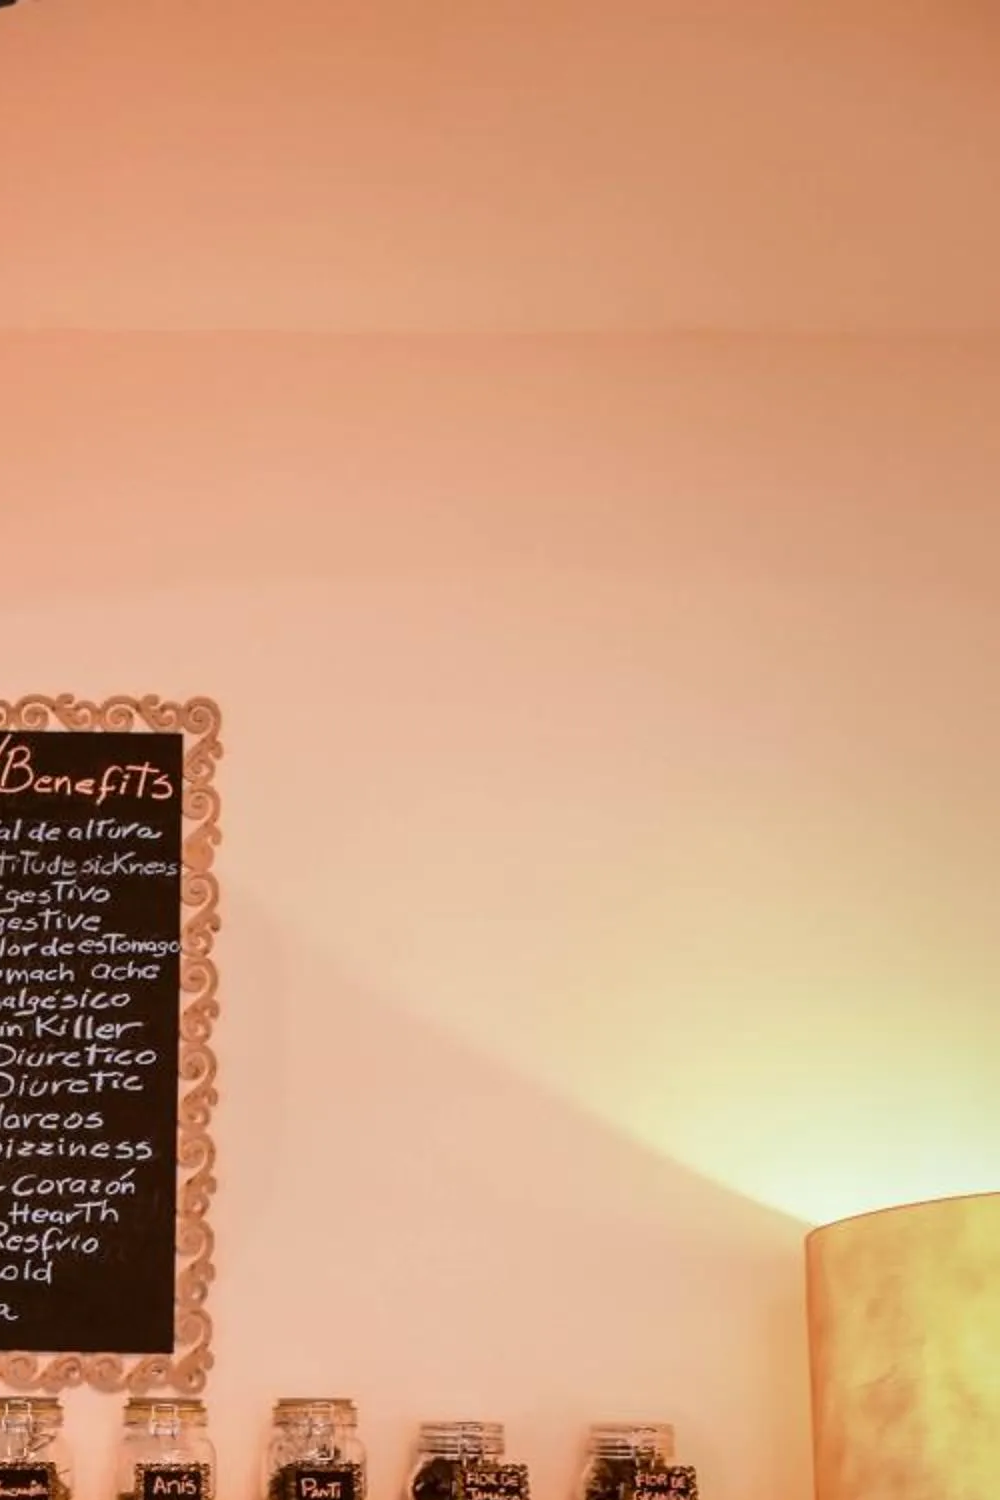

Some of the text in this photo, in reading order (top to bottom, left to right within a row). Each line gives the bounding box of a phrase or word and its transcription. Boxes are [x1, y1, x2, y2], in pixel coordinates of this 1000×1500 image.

[29, 821, 59, 842] de
[41, 937, 74, 956] de
[91, 961, 160, 981] ache
[35, 1014, 144, 1040] Killer
[11, 1168, 136, 1196] Corazón
